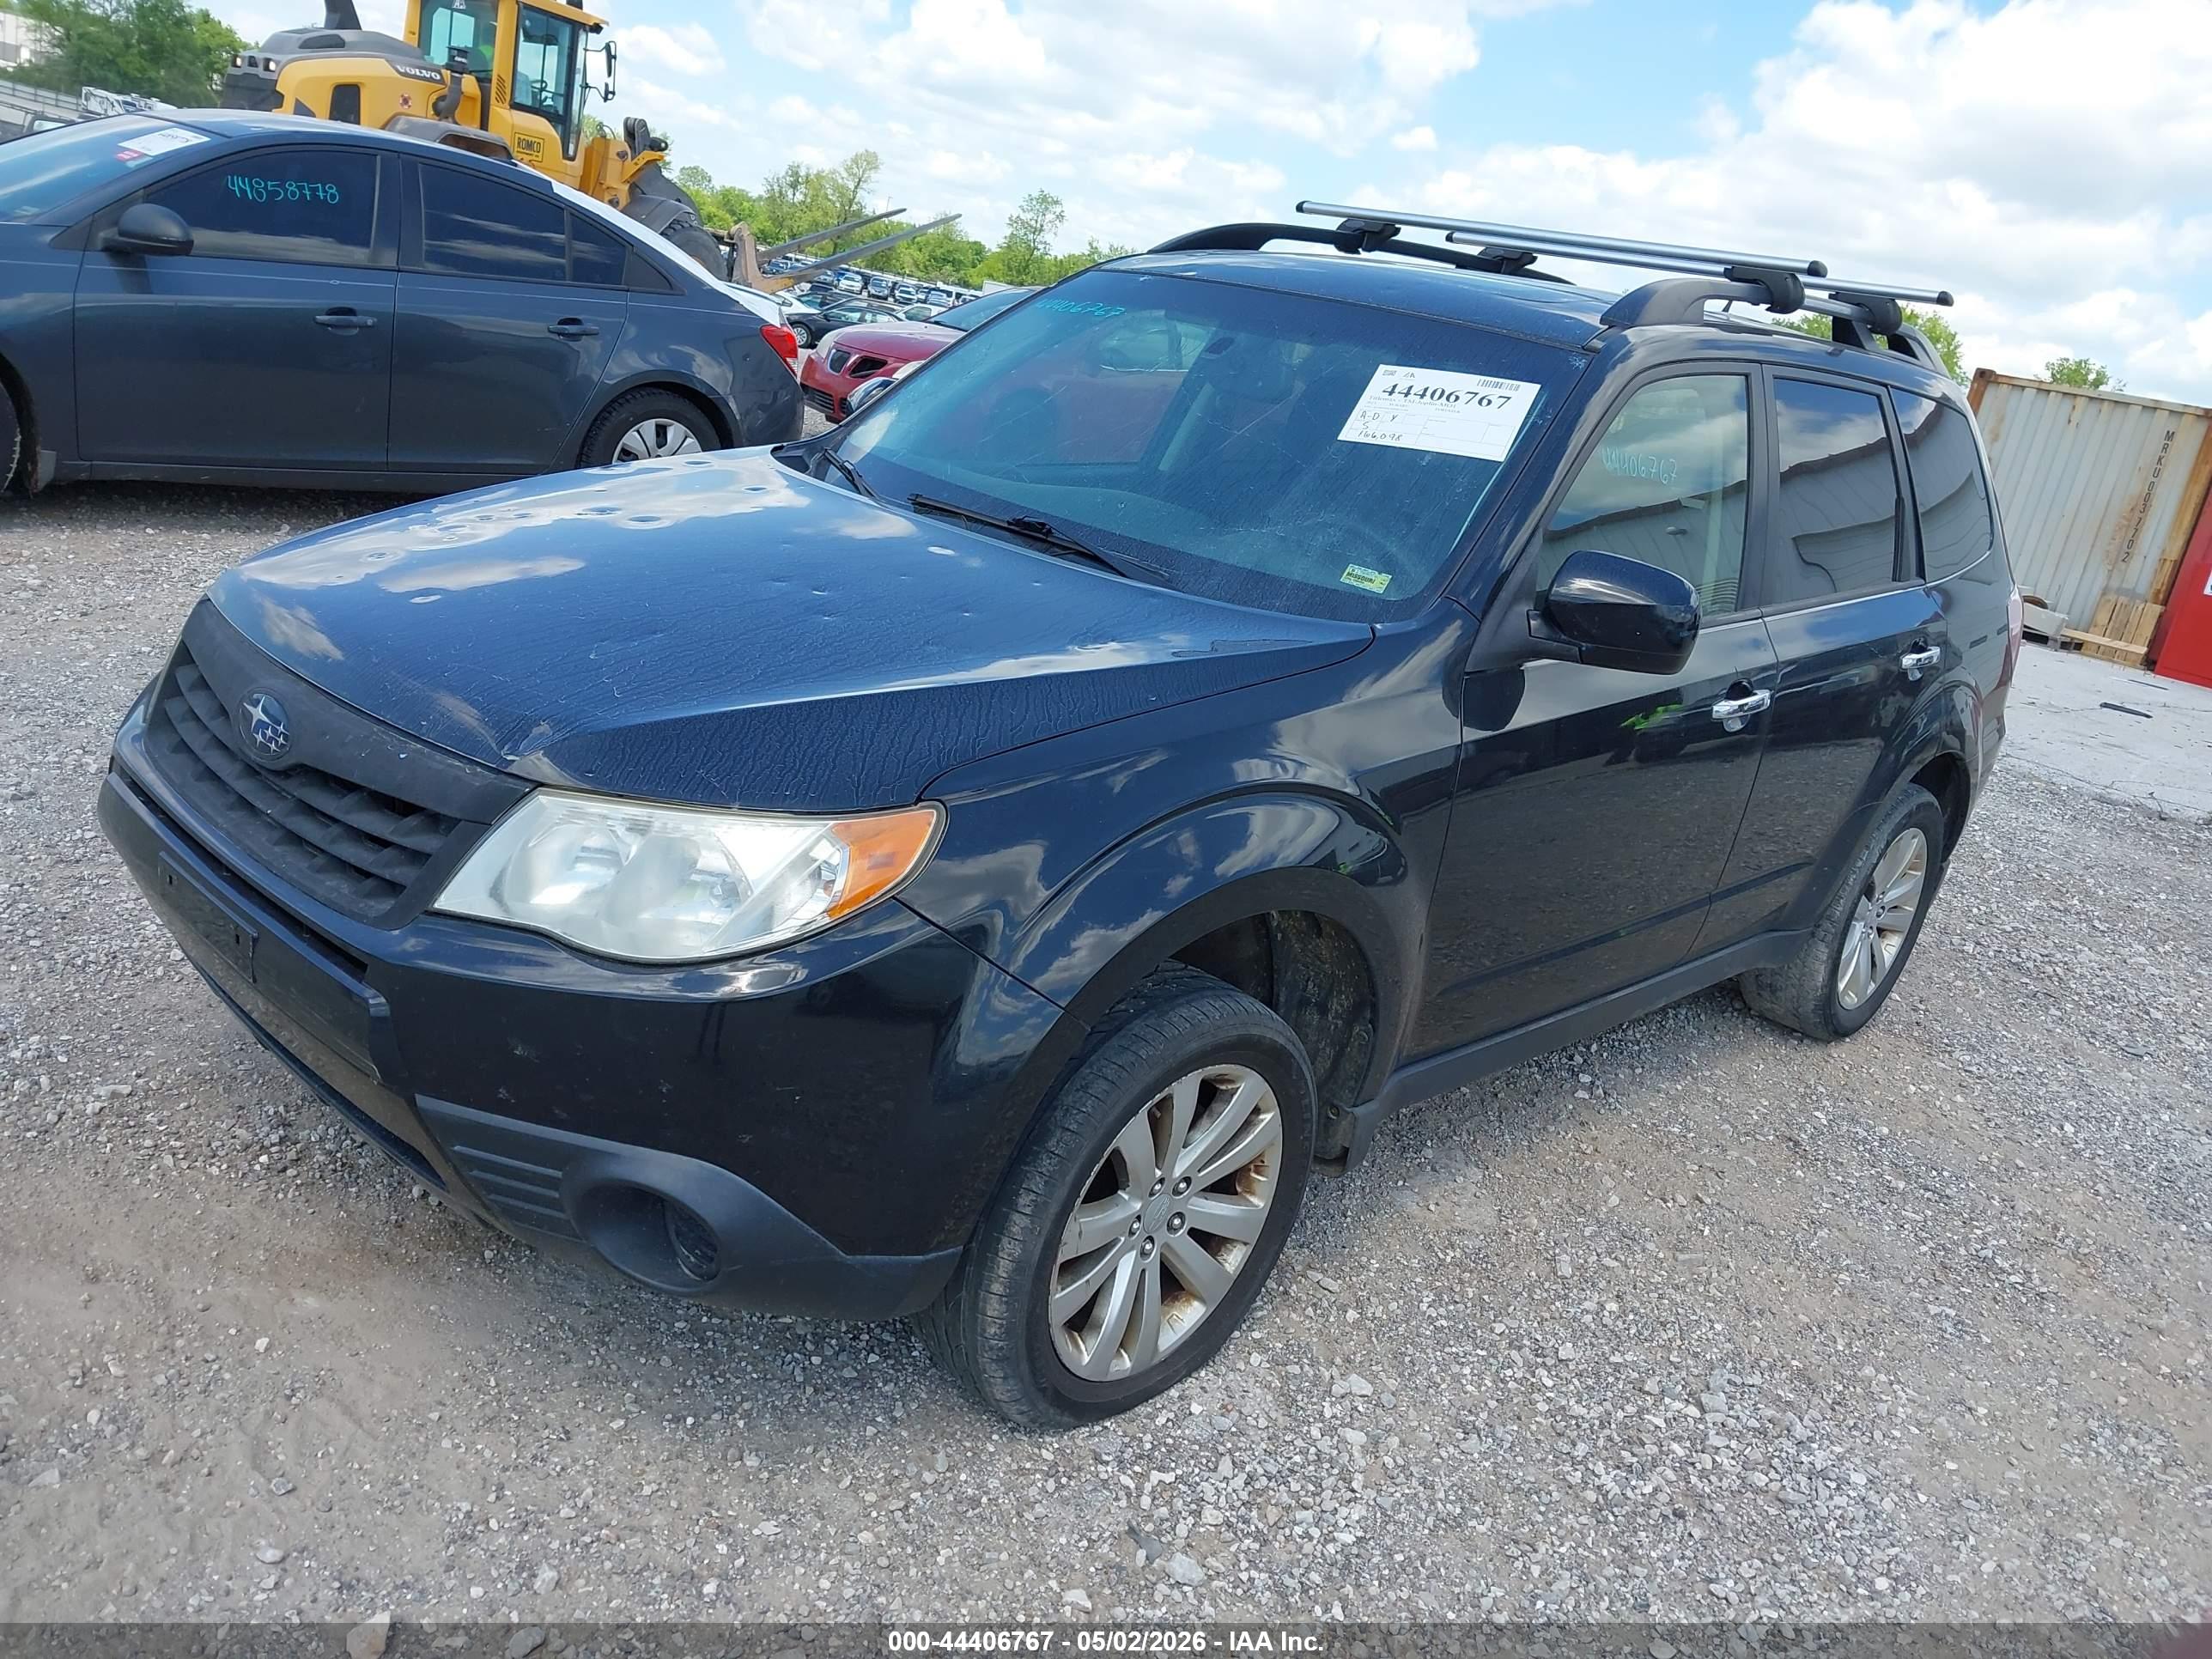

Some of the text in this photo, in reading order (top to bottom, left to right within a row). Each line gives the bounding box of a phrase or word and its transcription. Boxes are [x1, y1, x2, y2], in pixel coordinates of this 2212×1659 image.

[395, 64, 441, 81] VOLVO
[517, 137, 541, 154] ROMCO
[227, 174, 339, 204] 44858778
[1382, 383, 1511, 410] 44406767
